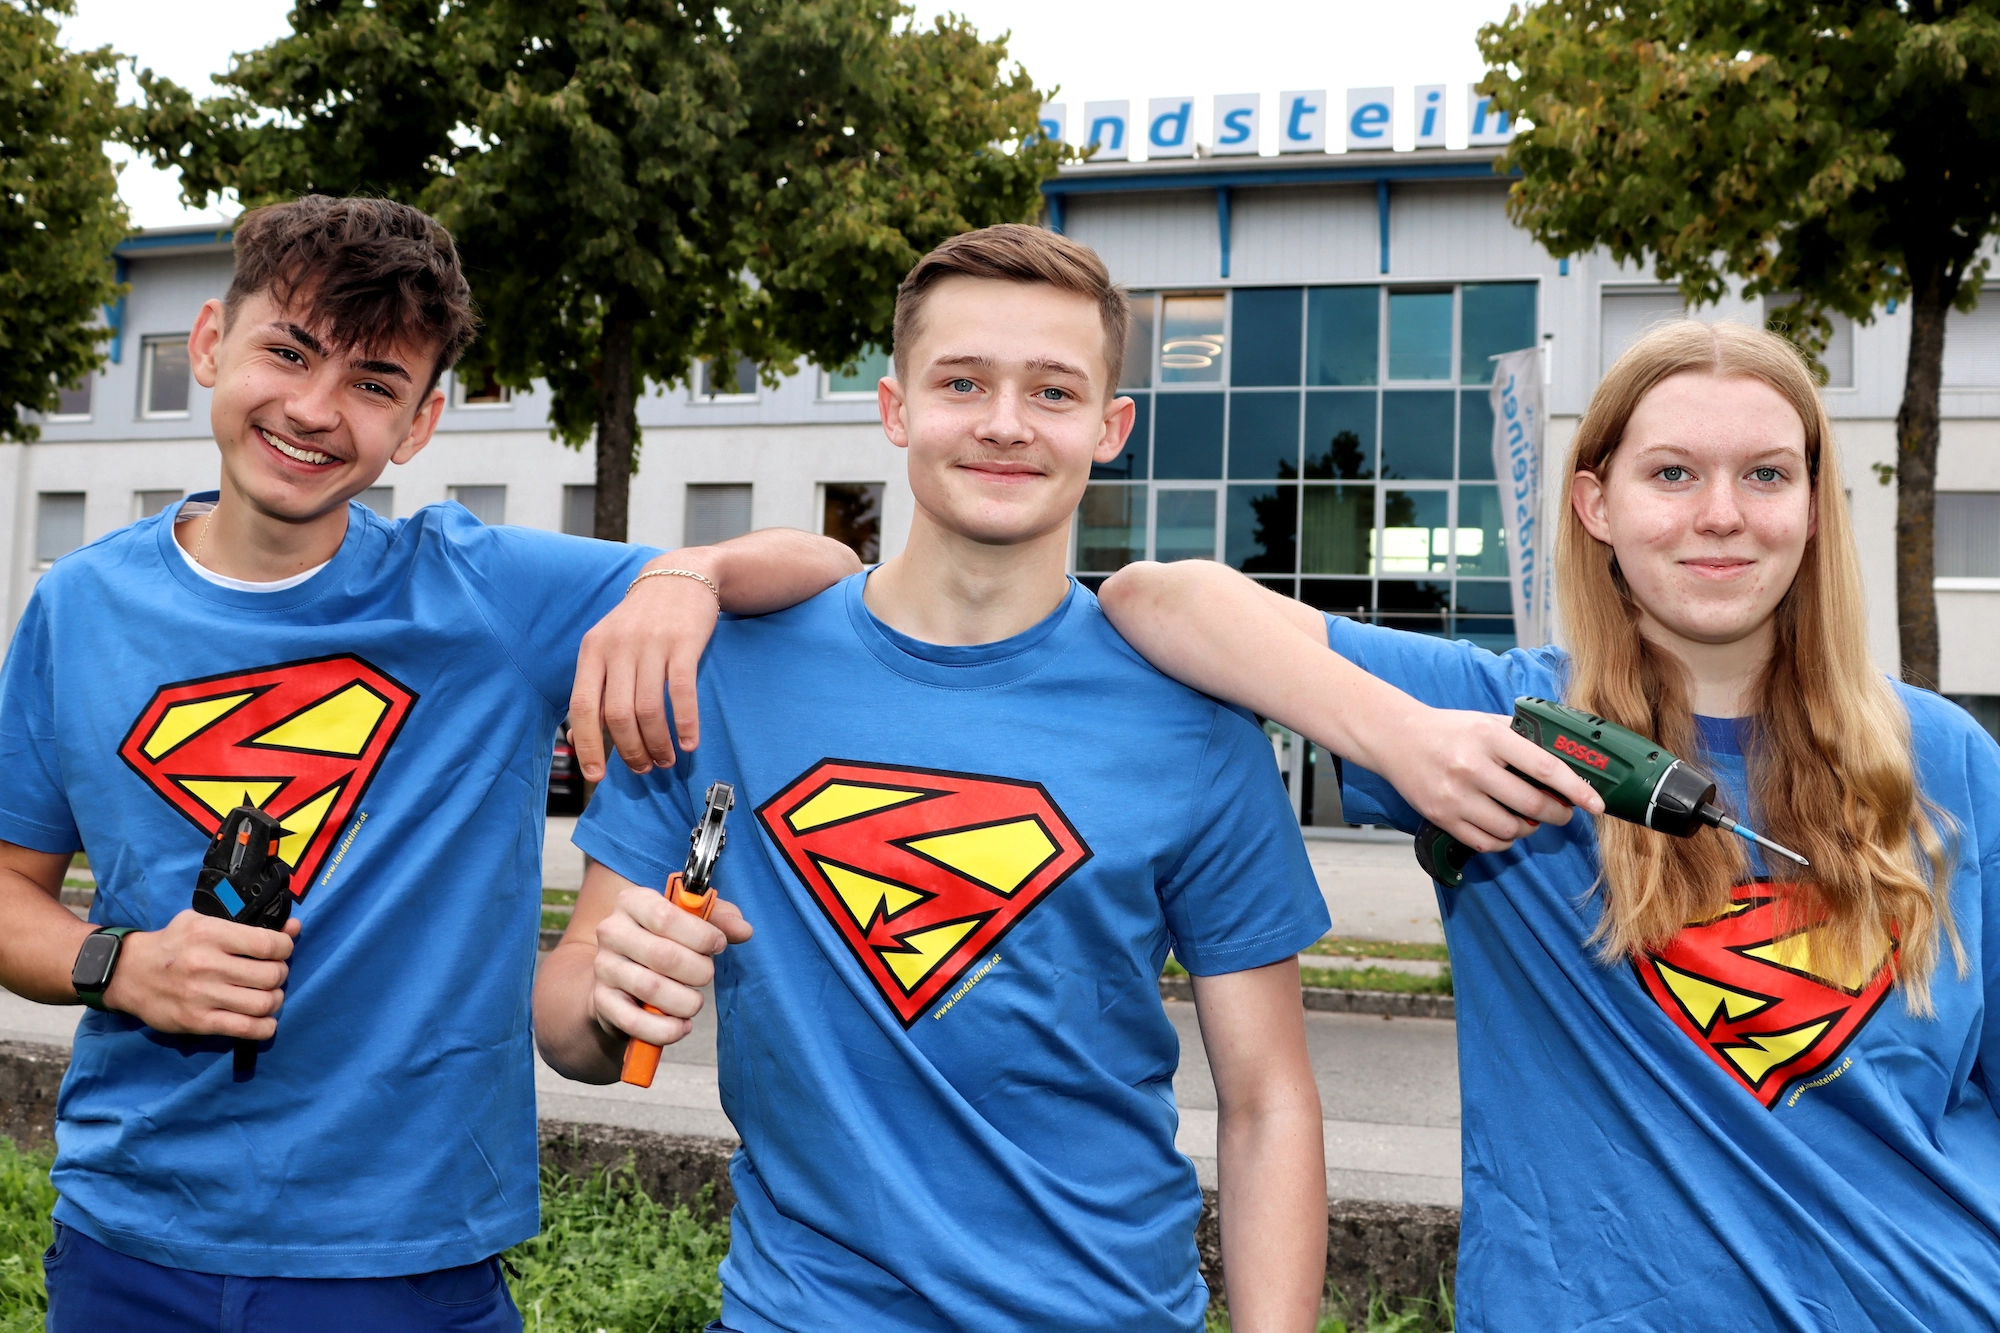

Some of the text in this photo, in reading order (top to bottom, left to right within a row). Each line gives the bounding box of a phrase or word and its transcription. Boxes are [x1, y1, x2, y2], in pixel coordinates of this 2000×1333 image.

[1553, 734, 1610, 771] BOSCH
[321, 811, 369, 886] www.landsteiner.at
[933, 953, 1002, 1020] www.landsteiner.at
